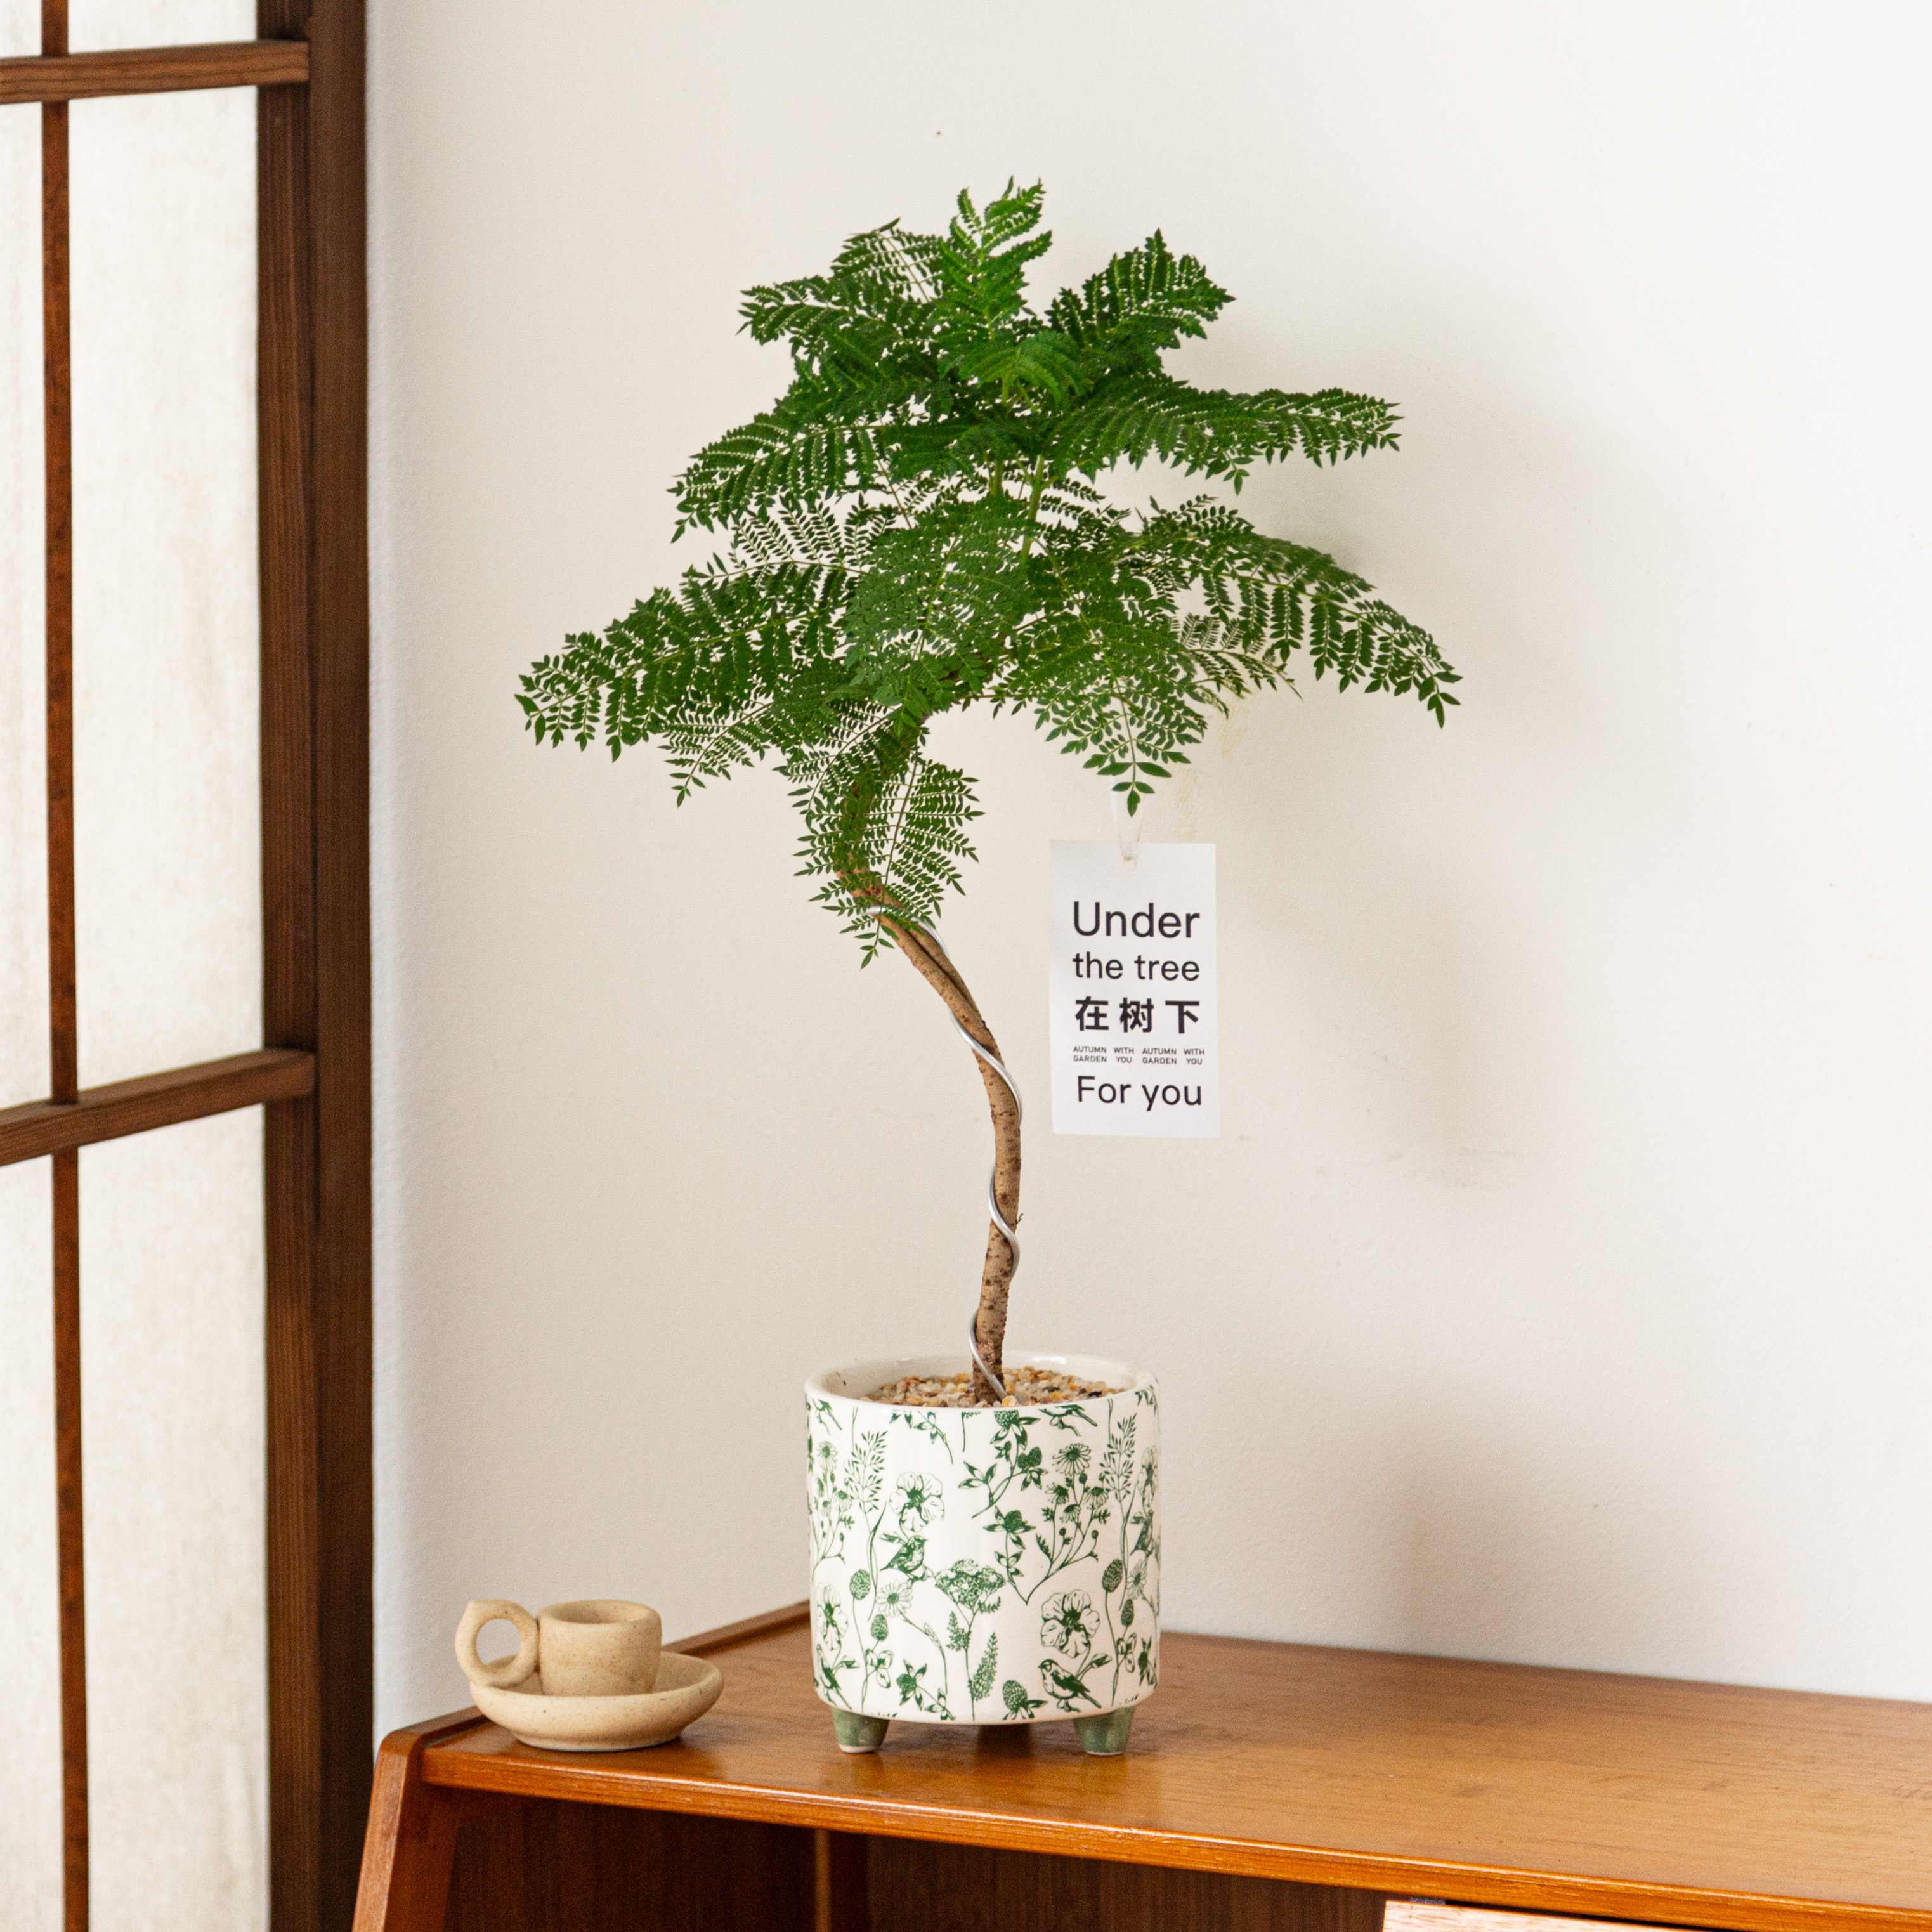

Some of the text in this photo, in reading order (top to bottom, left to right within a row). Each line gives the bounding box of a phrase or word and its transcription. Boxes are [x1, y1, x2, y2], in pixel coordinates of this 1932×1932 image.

[1073, 901, 1200, 939] Under
[1073, 951, 1200, 982] the tree
[1075, 996, 1200, 1035] 在树下
[1073, 1045, 1107, 1054] AUTUMN
[1142, 1047, 1177, 1055] AUTUMN
[1183, 1048, 1205, 1056] WITH
[1073, 1055, 1107, 1063] GARDEN
[1142, 1057, 1177, 1065] GARDEN
[1185, 1057, 1203, 1066] YOU
[1077, 1075, 1202, 1112] For you
